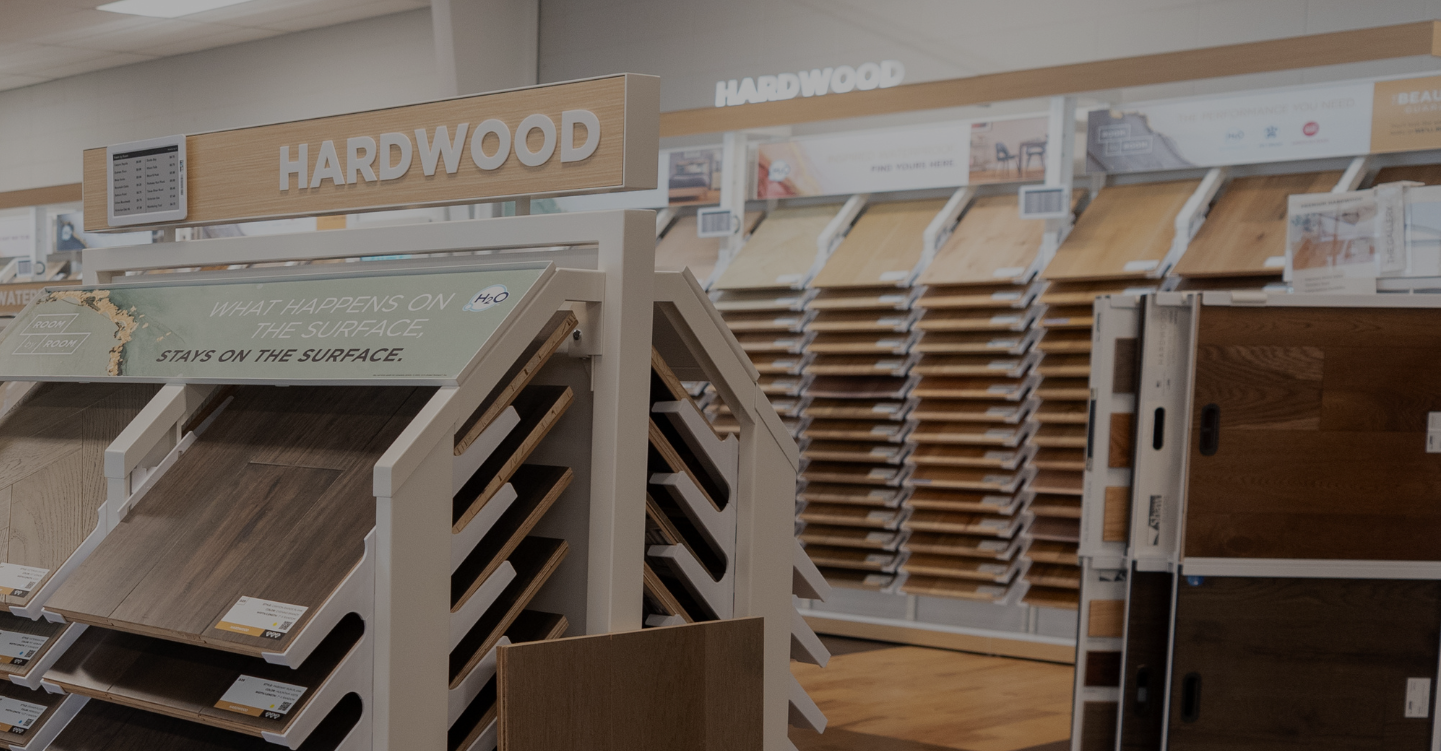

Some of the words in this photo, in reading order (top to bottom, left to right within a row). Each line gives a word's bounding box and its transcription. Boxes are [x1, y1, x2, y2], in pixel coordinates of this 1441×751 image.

[715, 59, 905, 107] HARDWOOD
[279, 108, 602, 191] HARDWOOD
[210, 299, 285, 318] WHAT
[280, 295, 405, 316] HAPPENS
[407, 293, 455, 312] ON
[32, 320, 66, 329] ROOM
[250, 322, 300, 340] THE
[301, 318, 430, 340] SURFACE,
[43, 339, 77, 348] ROOM
[156, 349, 217, 363] STAYS
[218, 349, 252, 363] ON
[253, 349, 298, 363] THE
[297, 347, 404, 363] SURFACE.
